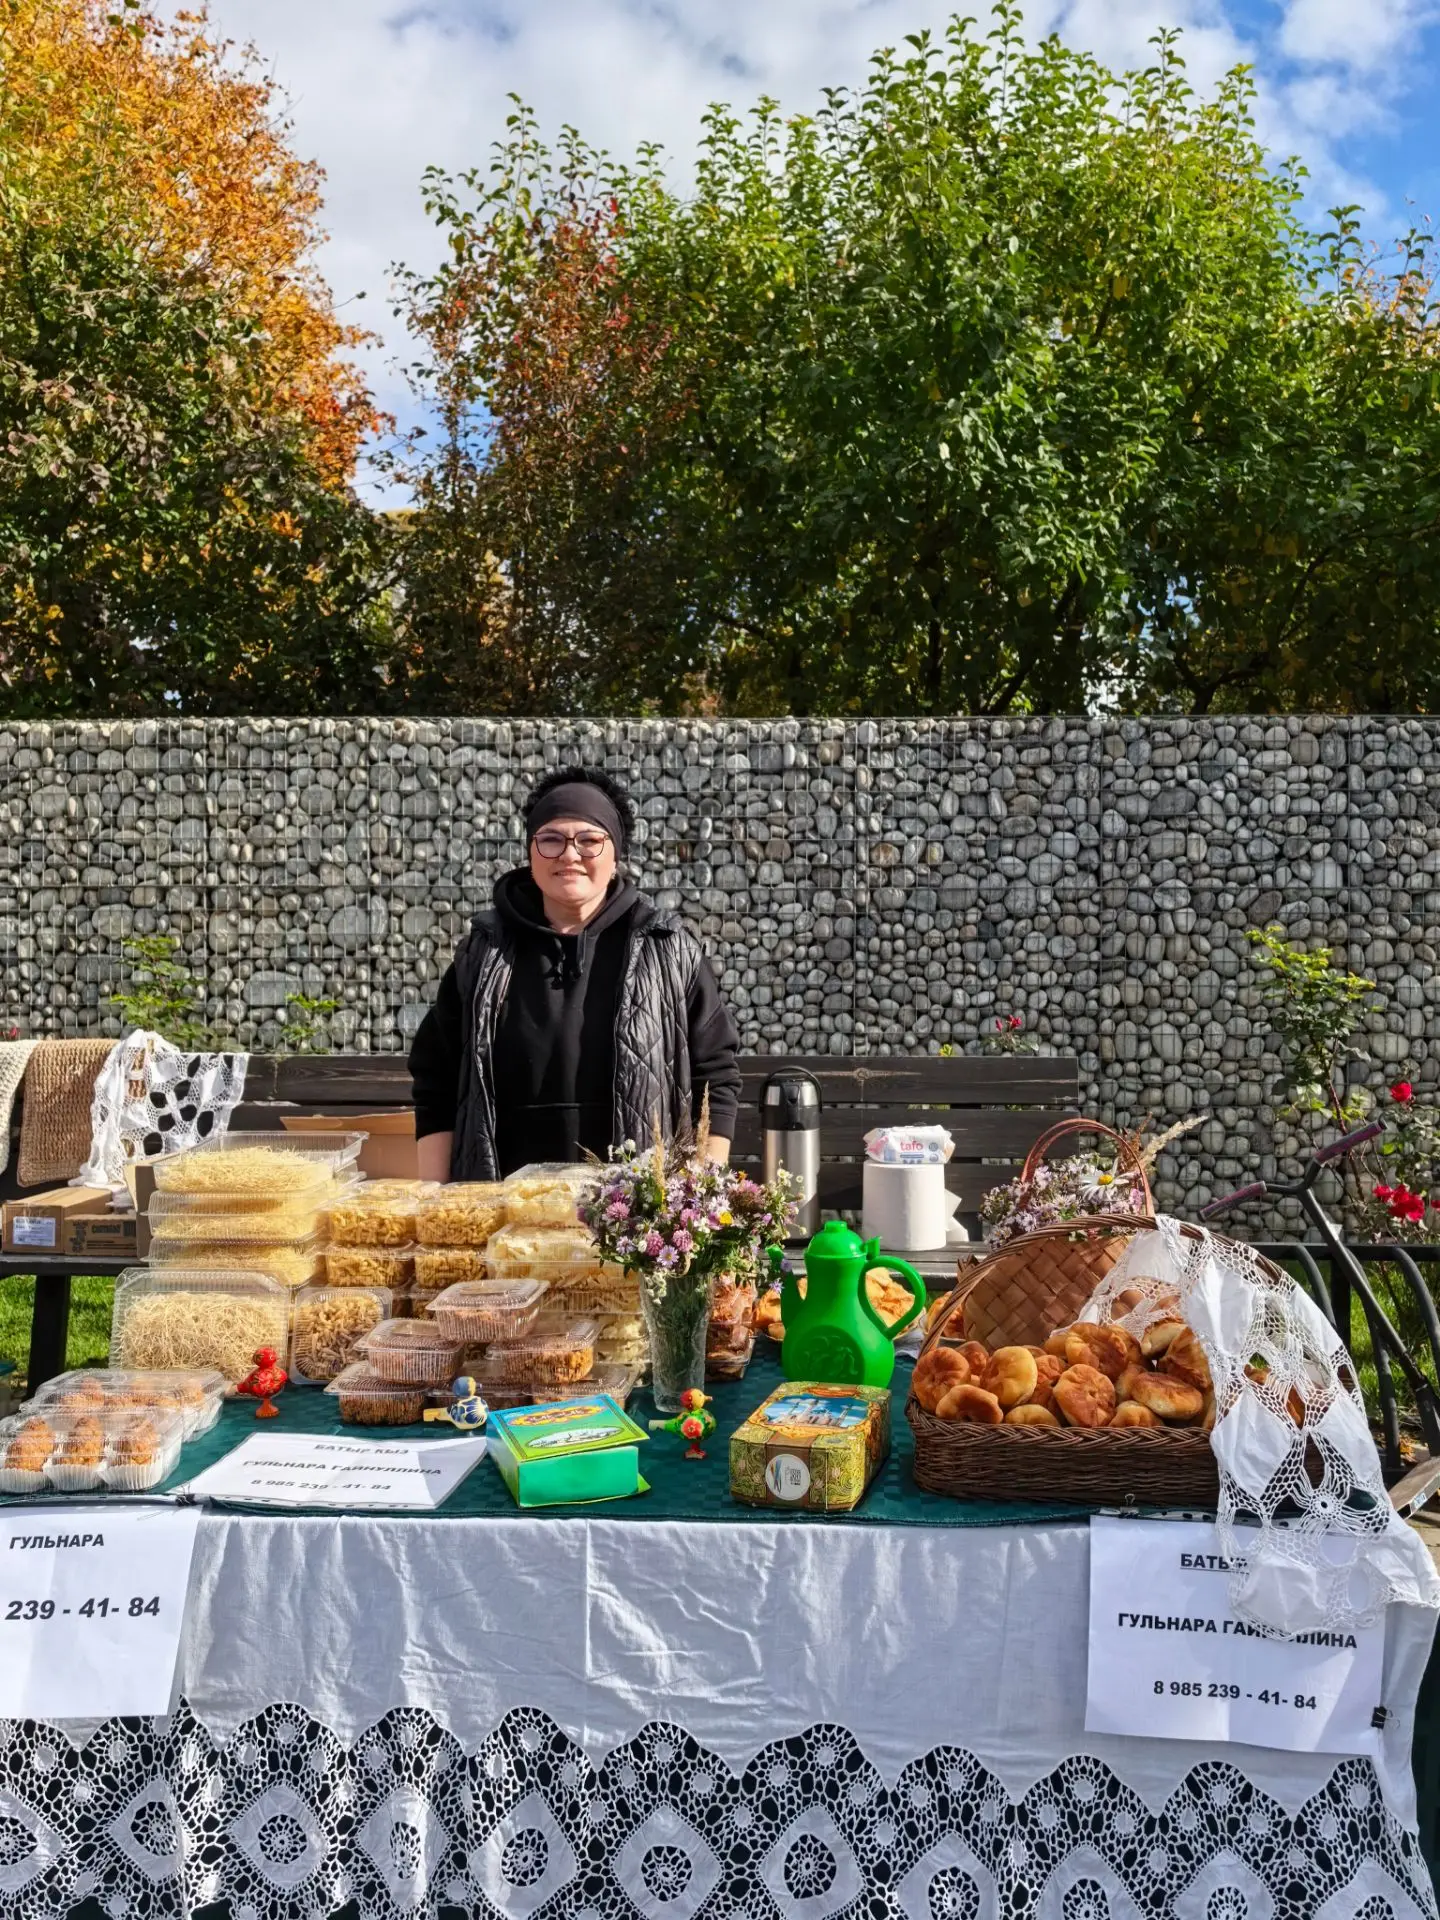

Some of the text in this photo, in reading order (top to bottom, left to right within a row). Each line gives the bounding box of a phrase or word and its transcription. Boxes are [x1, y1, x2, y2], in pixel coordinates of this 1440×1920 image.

[900, 1140, 924, 1152] tafo
[314, 1444, 370, 1454] БАТЫР
[243, 1460, 326, 1470] ГУЛЬНАРА
[298, 1482, 328, 1490] 239
[9, 1533, 105, 1549] ГУЛЬНАРА
[5, 1599, 56, 1620] 239
[127, 1596, 160, 1617] 84
[1118, 1613, 1358, 1649] ГУЛЬНАРА ГАЙЛИНА
[1153, 1680, 1164, 1695] 8
[1169, 1681, 1203, 1697] 985
[1207, 1683, 1241, 1699] 239
[1294, 1694, 1317, 1710] 84
